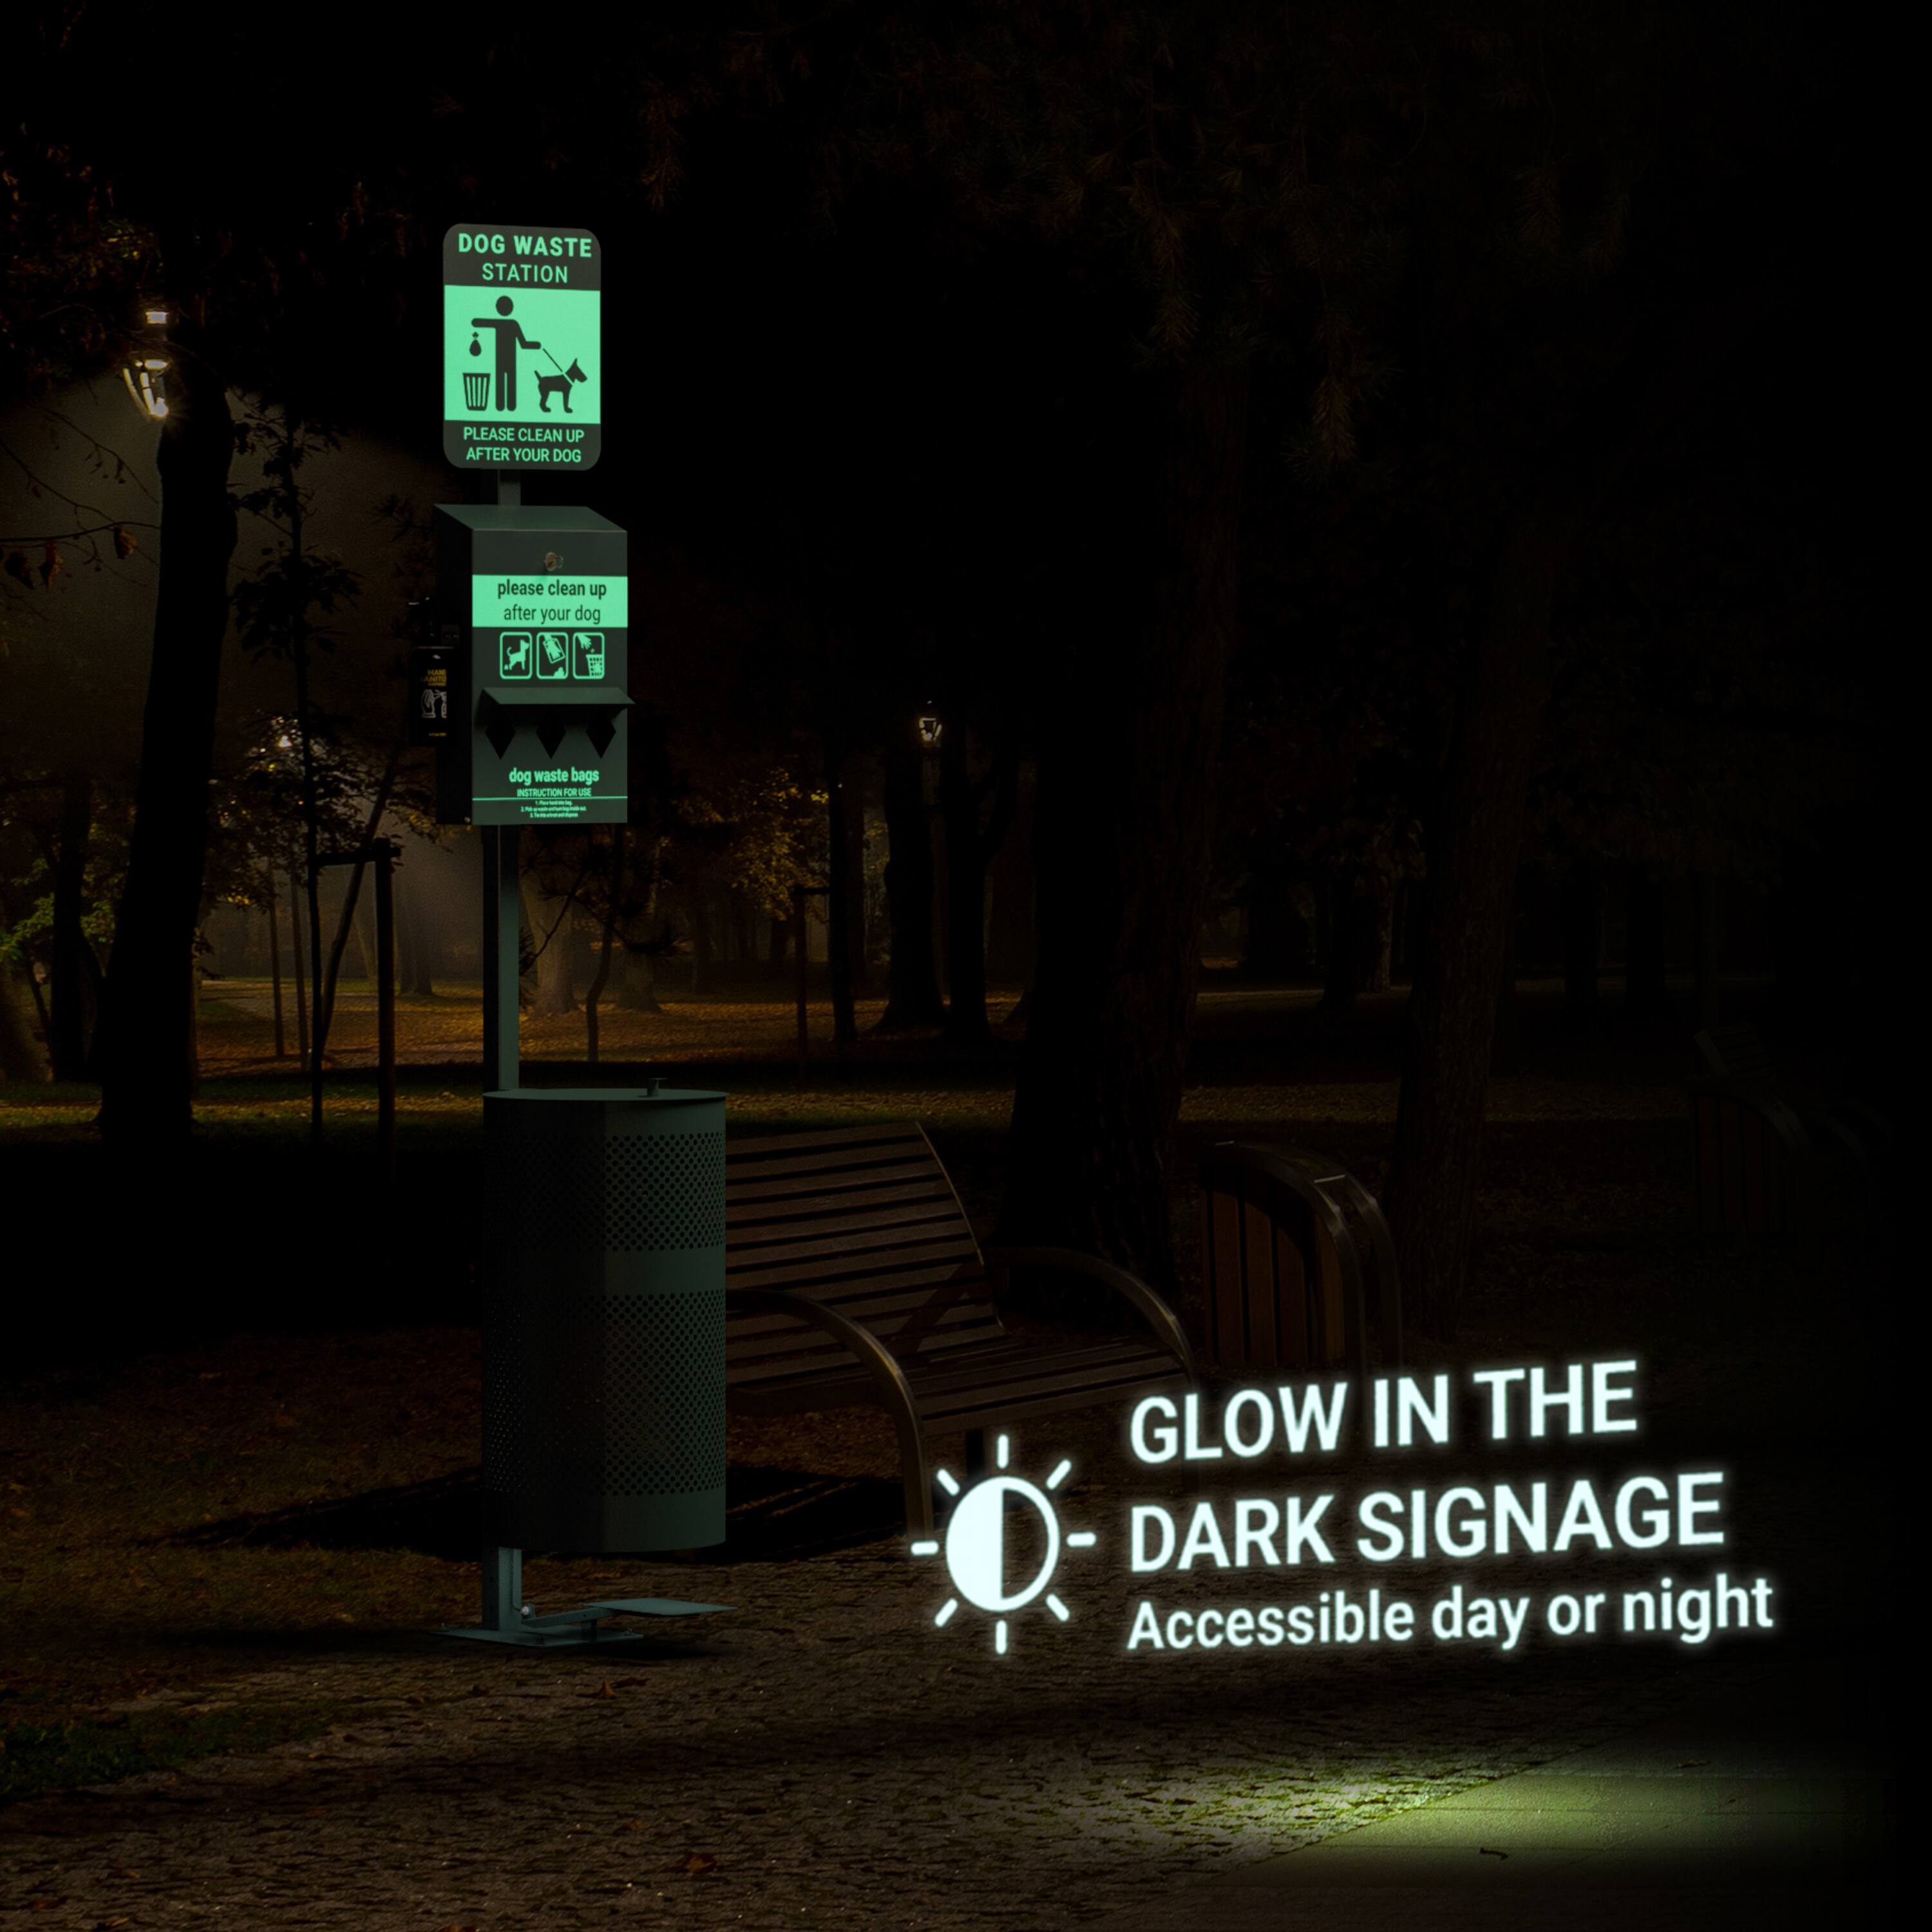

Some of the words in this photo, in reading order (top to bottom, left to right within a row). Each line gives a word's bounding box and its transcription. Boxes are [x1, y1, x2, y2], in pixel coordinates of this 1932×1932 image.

[459, 233, 505, 254] DOG
[514, 236, 591, 257] WASTE
[482, 263, 567, 283] STATION
[464, 427, 515, 440] PLEASE
[518, 428, 562, 442] CLEAN
[566, 430, 584, 442] UP
[466, 447, 509, 460] AFTER
[513, 448, 549, 461] YOUR
[553, 449, 581, 462] DOG
[498, 579, 544, 599] please
[548, 580, 585, 595] clean
[590, 585, 606, 600] up
[504, 604, 536, 620] after
[541, 609, 571, 625] your
[575, 605, 600, 625] dog
[509, 768, 531, 786] dog
[535, 769, 569, 782] waste
[571, 767, 599, 785] bags
